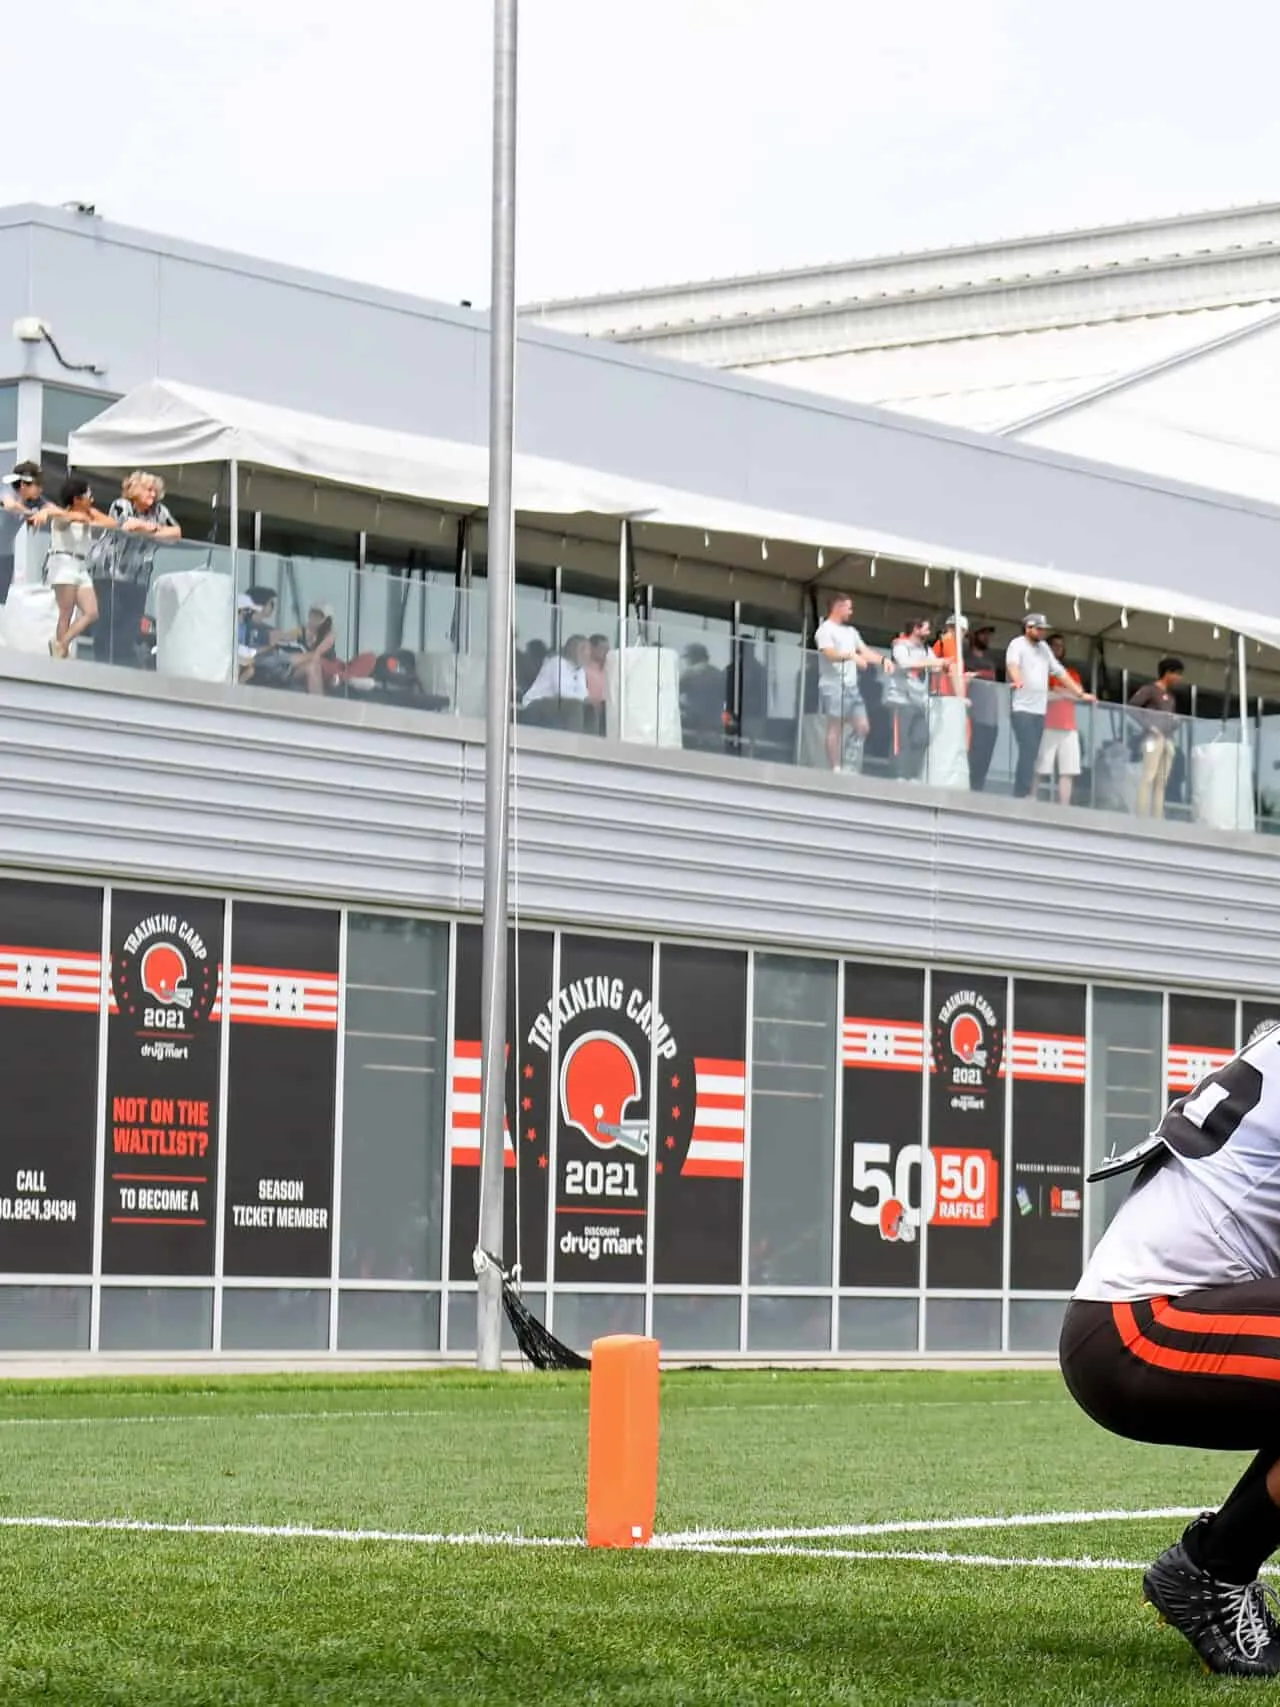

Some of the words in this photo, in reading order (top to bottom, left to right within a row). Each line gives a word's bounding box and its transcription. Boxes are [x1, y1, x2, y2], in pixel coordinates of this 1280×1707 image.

[123, 913, 177, 955] TRAINING
[178, 920, 207, 960] CAMP
[143, 1007, 185, 1030] 2021
[527, 976, 624, 1052] TRAINING
[626, 988, 677, 1060] CAMP
[140, 1043, 163, 1061] drug
[952, 1067, 982, 1085] 2021
[113, 1097, 148, 1124] NOT
[151, 1098, 174, 1125] ON
[177, 1100, 209, 1127] THE
[113, 1128, 209, 1157] WAITLIST?
[16, 1169, 47, 1193] CALL
[258, 1179, 304, 1201] SEASON
[565, 1160, 638, 1197] 2021
[850, 1141, 937, 1227] 50
[940, 1154, 985, 1200] 50
[120, 1188, 136, 1210] TO
[138, 1188, 188, 1211] BECOME
[190, 1189, 199, 1212] A
[939, 1201, 985, 1219] RAFFLE
[232, 1205, 275, 1227] TICKET
[276, 1206, 328, 1229] MEMBER
[560, 1230, 600, 1260] drug
[602, 1234, 643, 1256] mart
